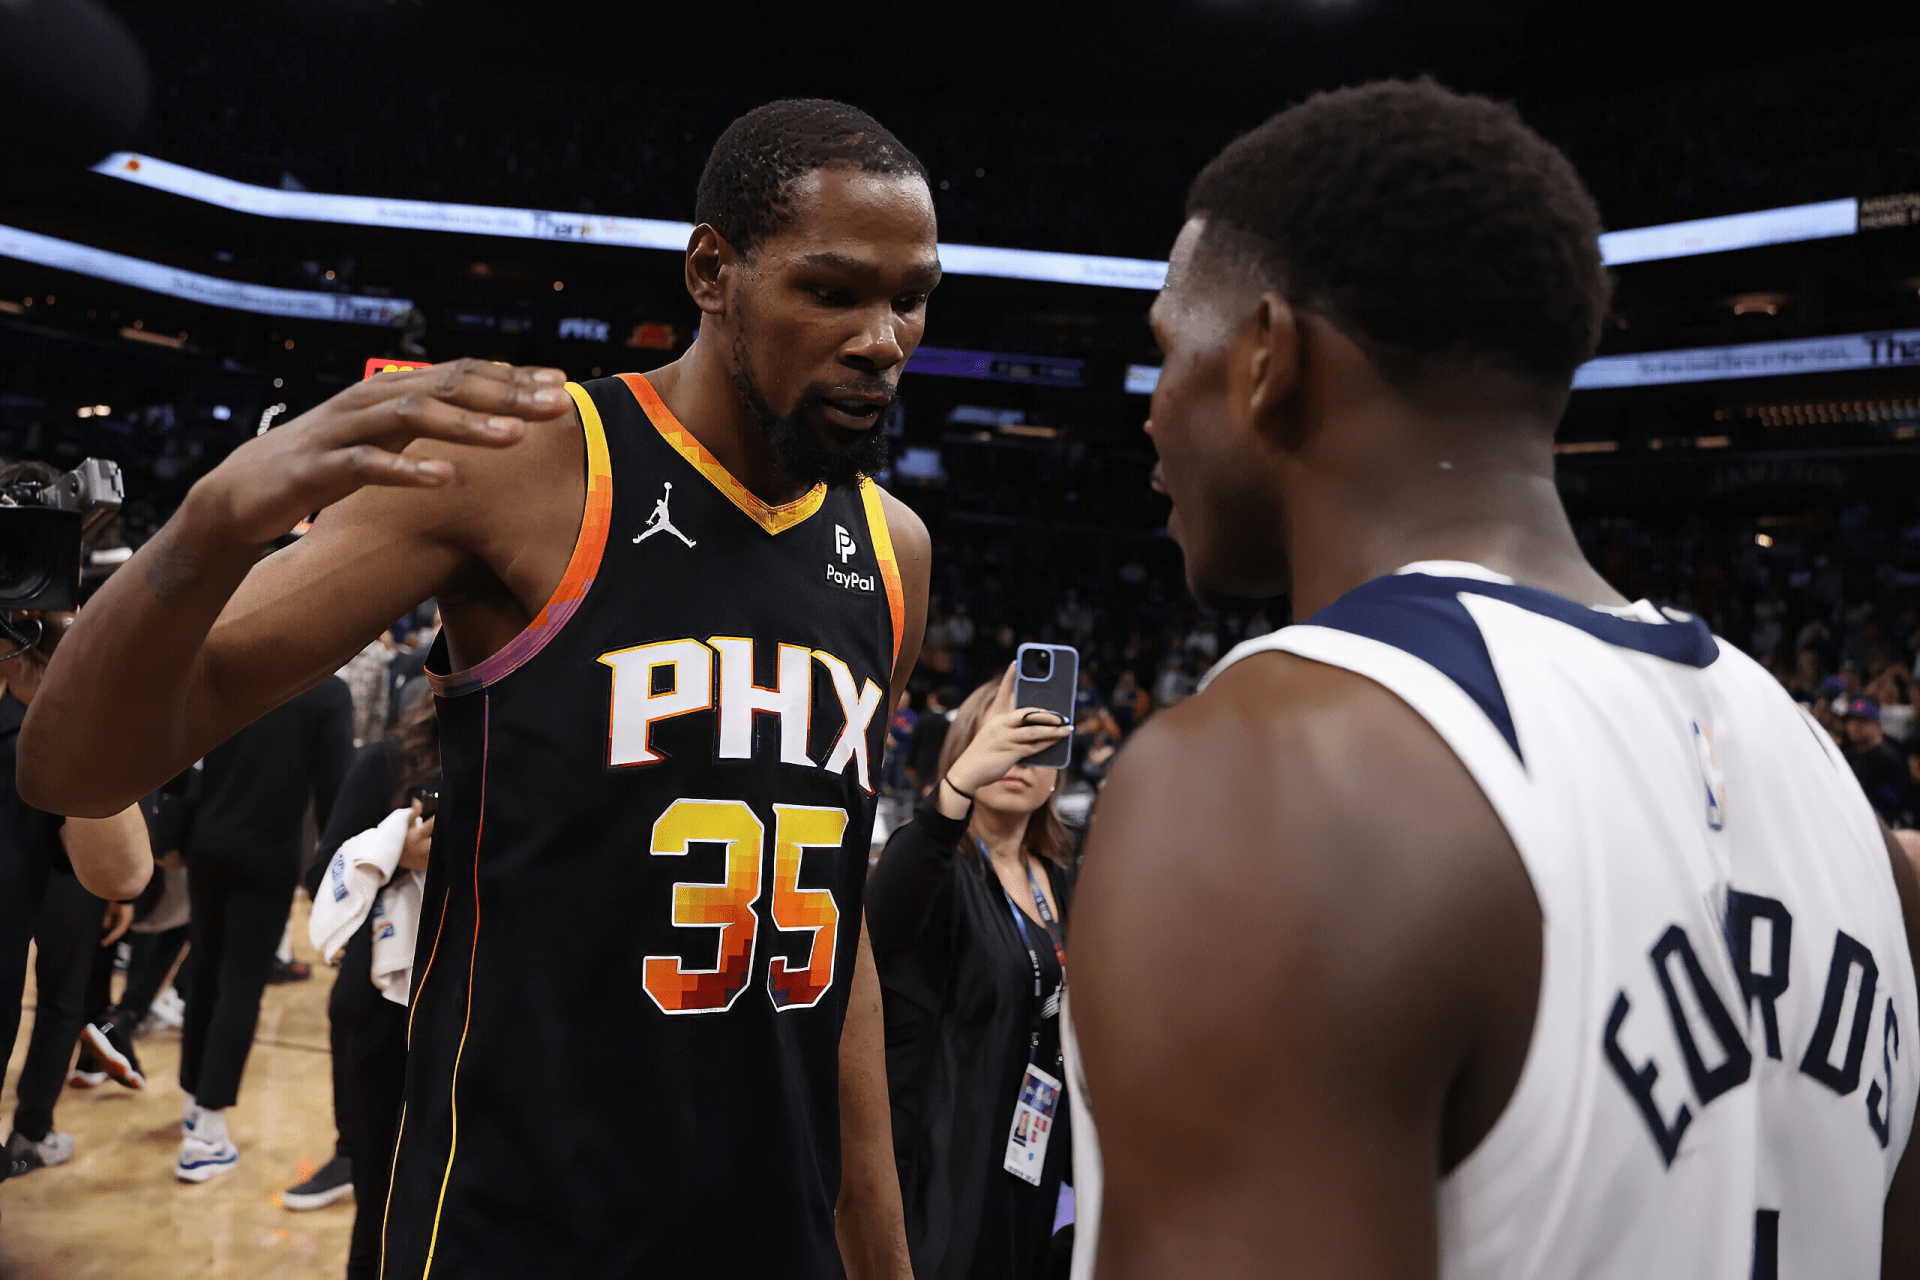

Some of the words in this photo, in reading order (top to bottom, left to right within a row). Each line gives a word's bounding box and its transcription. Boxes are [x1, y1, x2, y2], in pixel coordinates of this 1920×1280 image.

[826, 563, 875, 591] PayPal
[597, 636, 883, 795] PHX
[643, 798, 849, 1014] 35
[1602, 880, 1900, 1168] EDRDS
